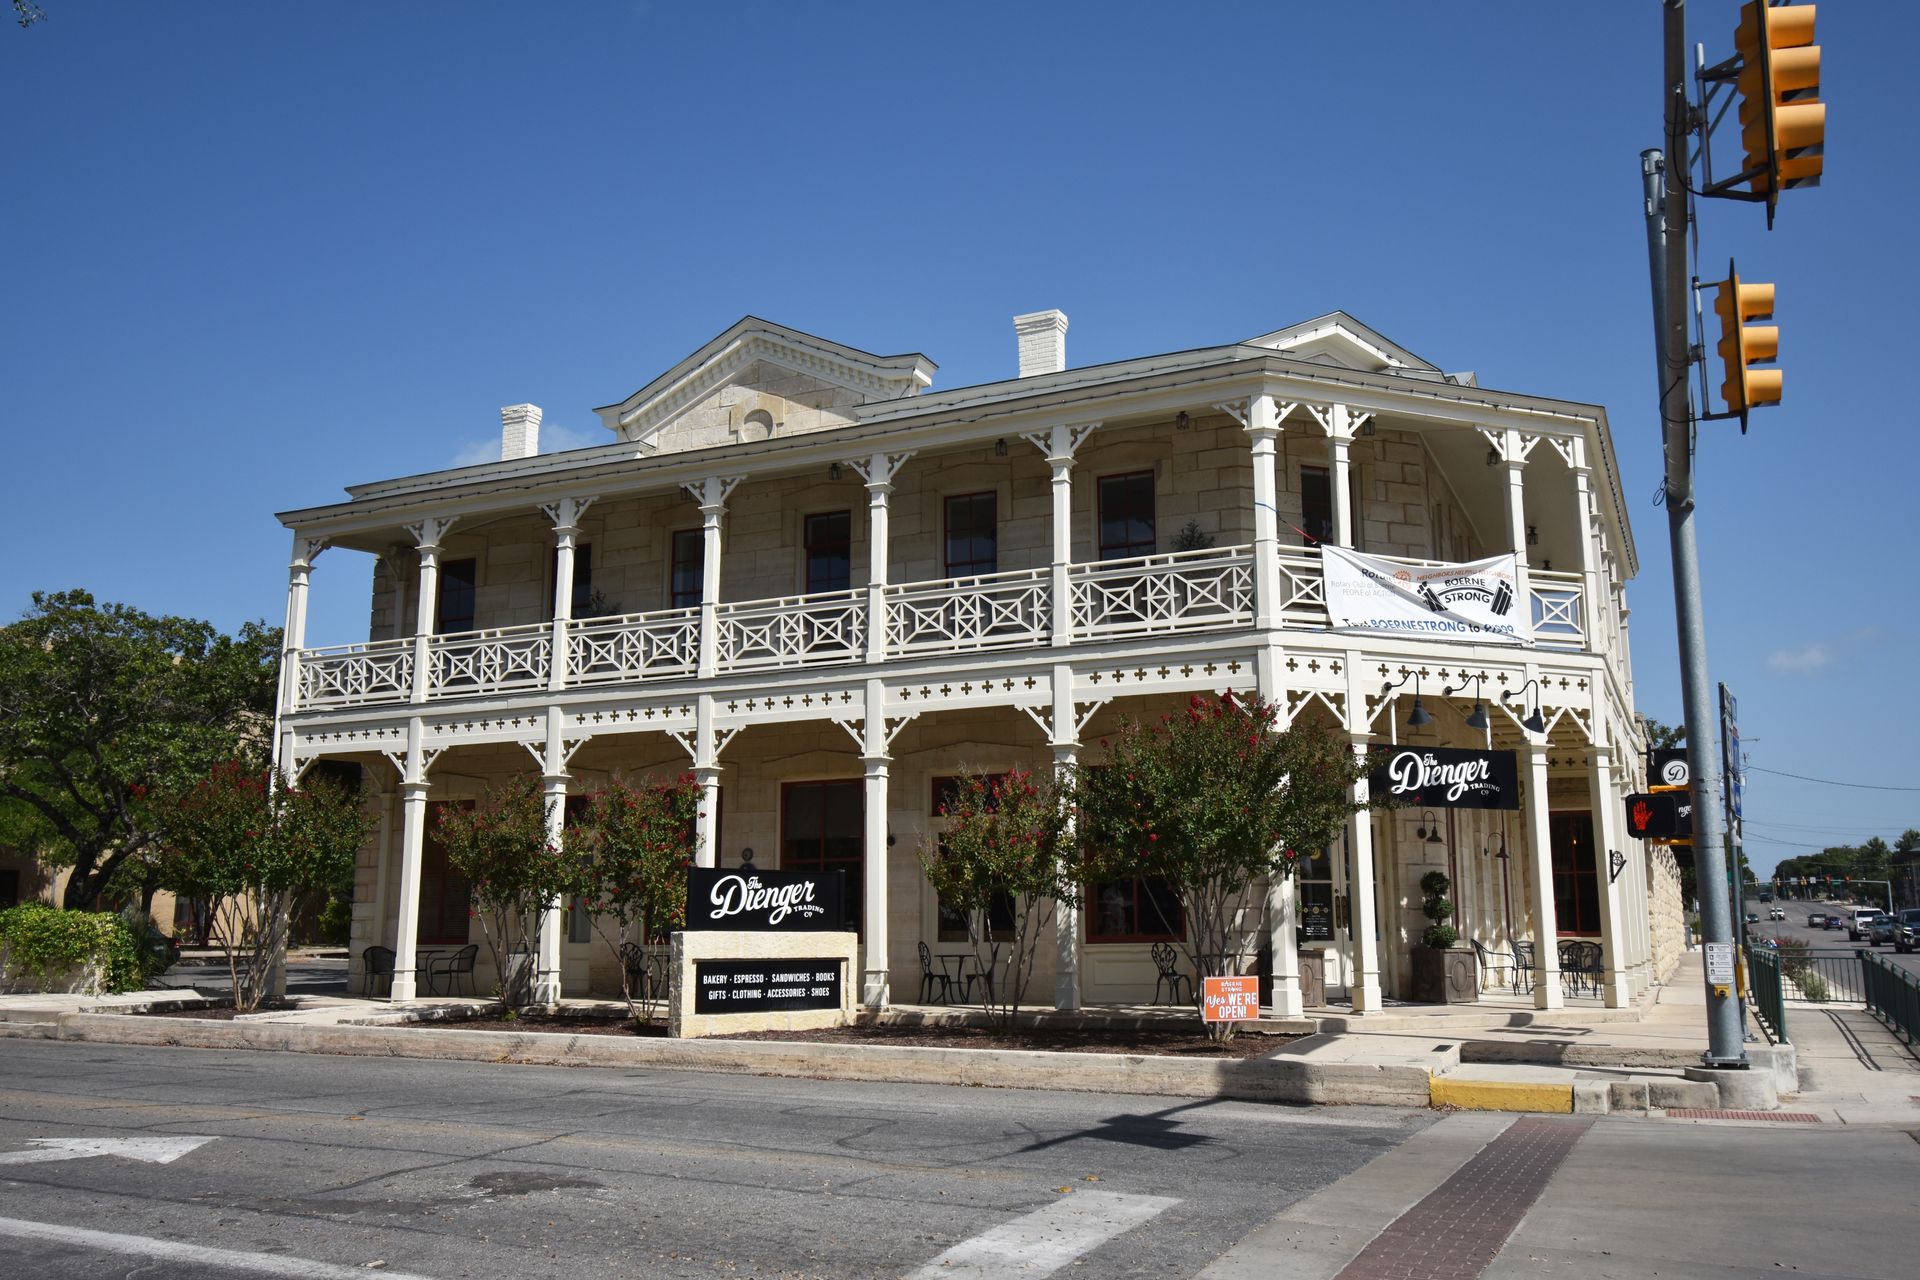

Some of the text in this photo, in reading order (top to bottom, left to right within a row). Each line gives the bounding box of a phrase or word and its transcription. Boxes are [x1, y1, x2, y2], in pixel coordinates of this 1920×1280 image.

[1444, 577, 1486, 587] BOERNE
[1444, 591, 1490, 603] STRONG
[1370, 619, 1466, 632] BOERNESTRONG
[1469, 623, 1480, 633] to
[1424, 753, 1438, 766] The
[1388, 751, 1490, 802] Dienger
[1668, 764, 1686, 782] D
[1469, 783, 1501, 792] TRADING
[747, 876, 763, 890] The
[710, 875, 815, 925] Dienger
[793, 904, 825, 914] TRADING
[703, 972, 835, 985] BAKERY ESPRESSO SANDWICHES BOOKS
[708, 987, 830, 1000] GIFTS CLOTHING ACCESSORIES SHOES
[1206, 992, 1257, 1009] Yes WE'RE
[1219, 1005, 1247, 1018] OPEN!
